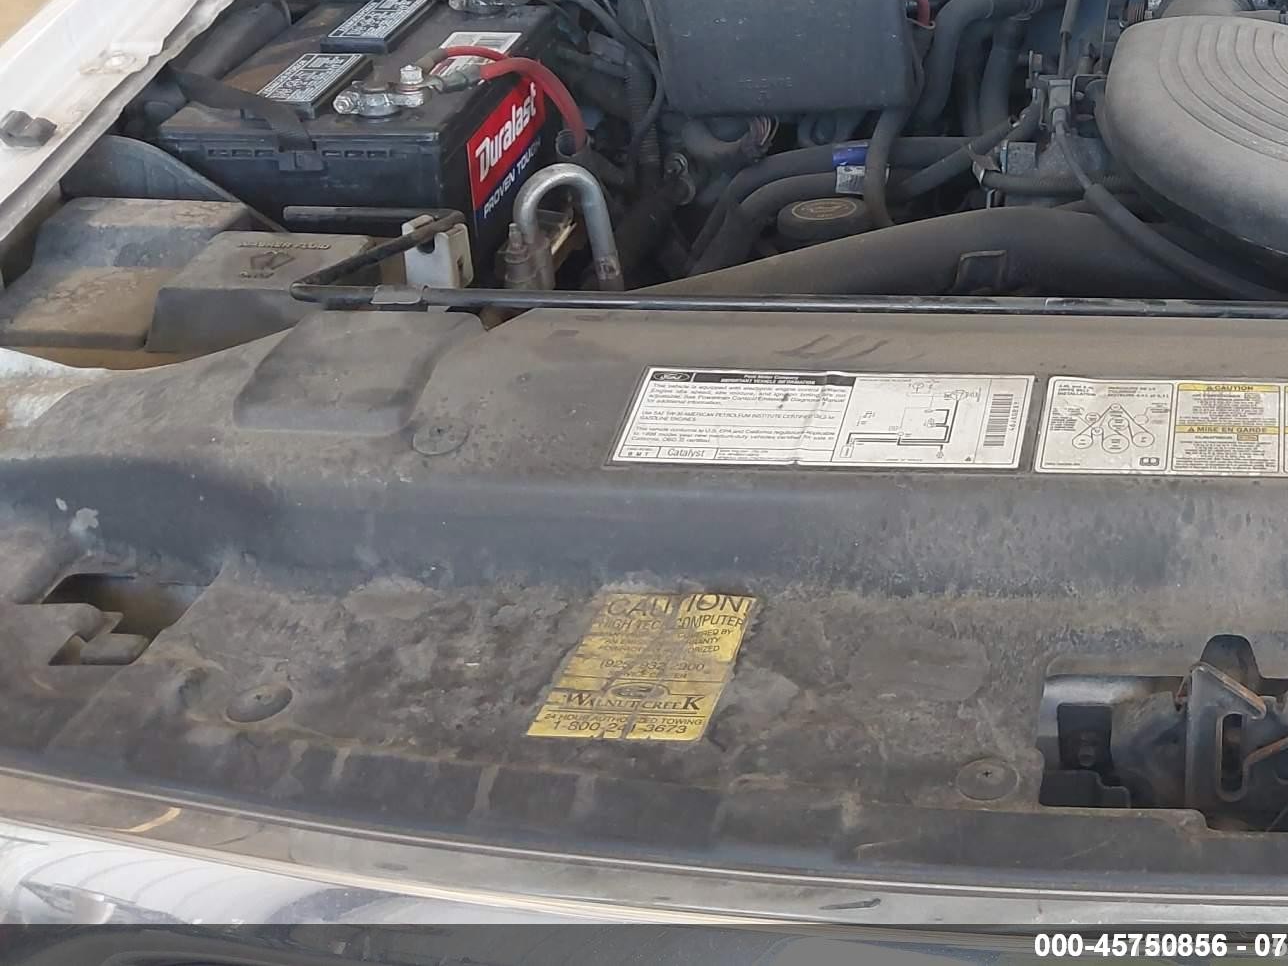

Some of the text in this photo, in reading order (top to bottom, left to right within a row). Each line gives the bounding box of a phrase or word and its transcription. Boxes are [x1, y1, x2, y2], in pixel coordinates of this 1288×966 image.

[475, 81, 537, 183] Duralast
[484, 168, 516, 219] PROVEN
[667, 448, 706, 458] Catalyst
[565, 693, 705, 710] WALNUT CREEK
[560, 714, 589, 722] HOUR
[661, 717, 703, 725] TOWING
